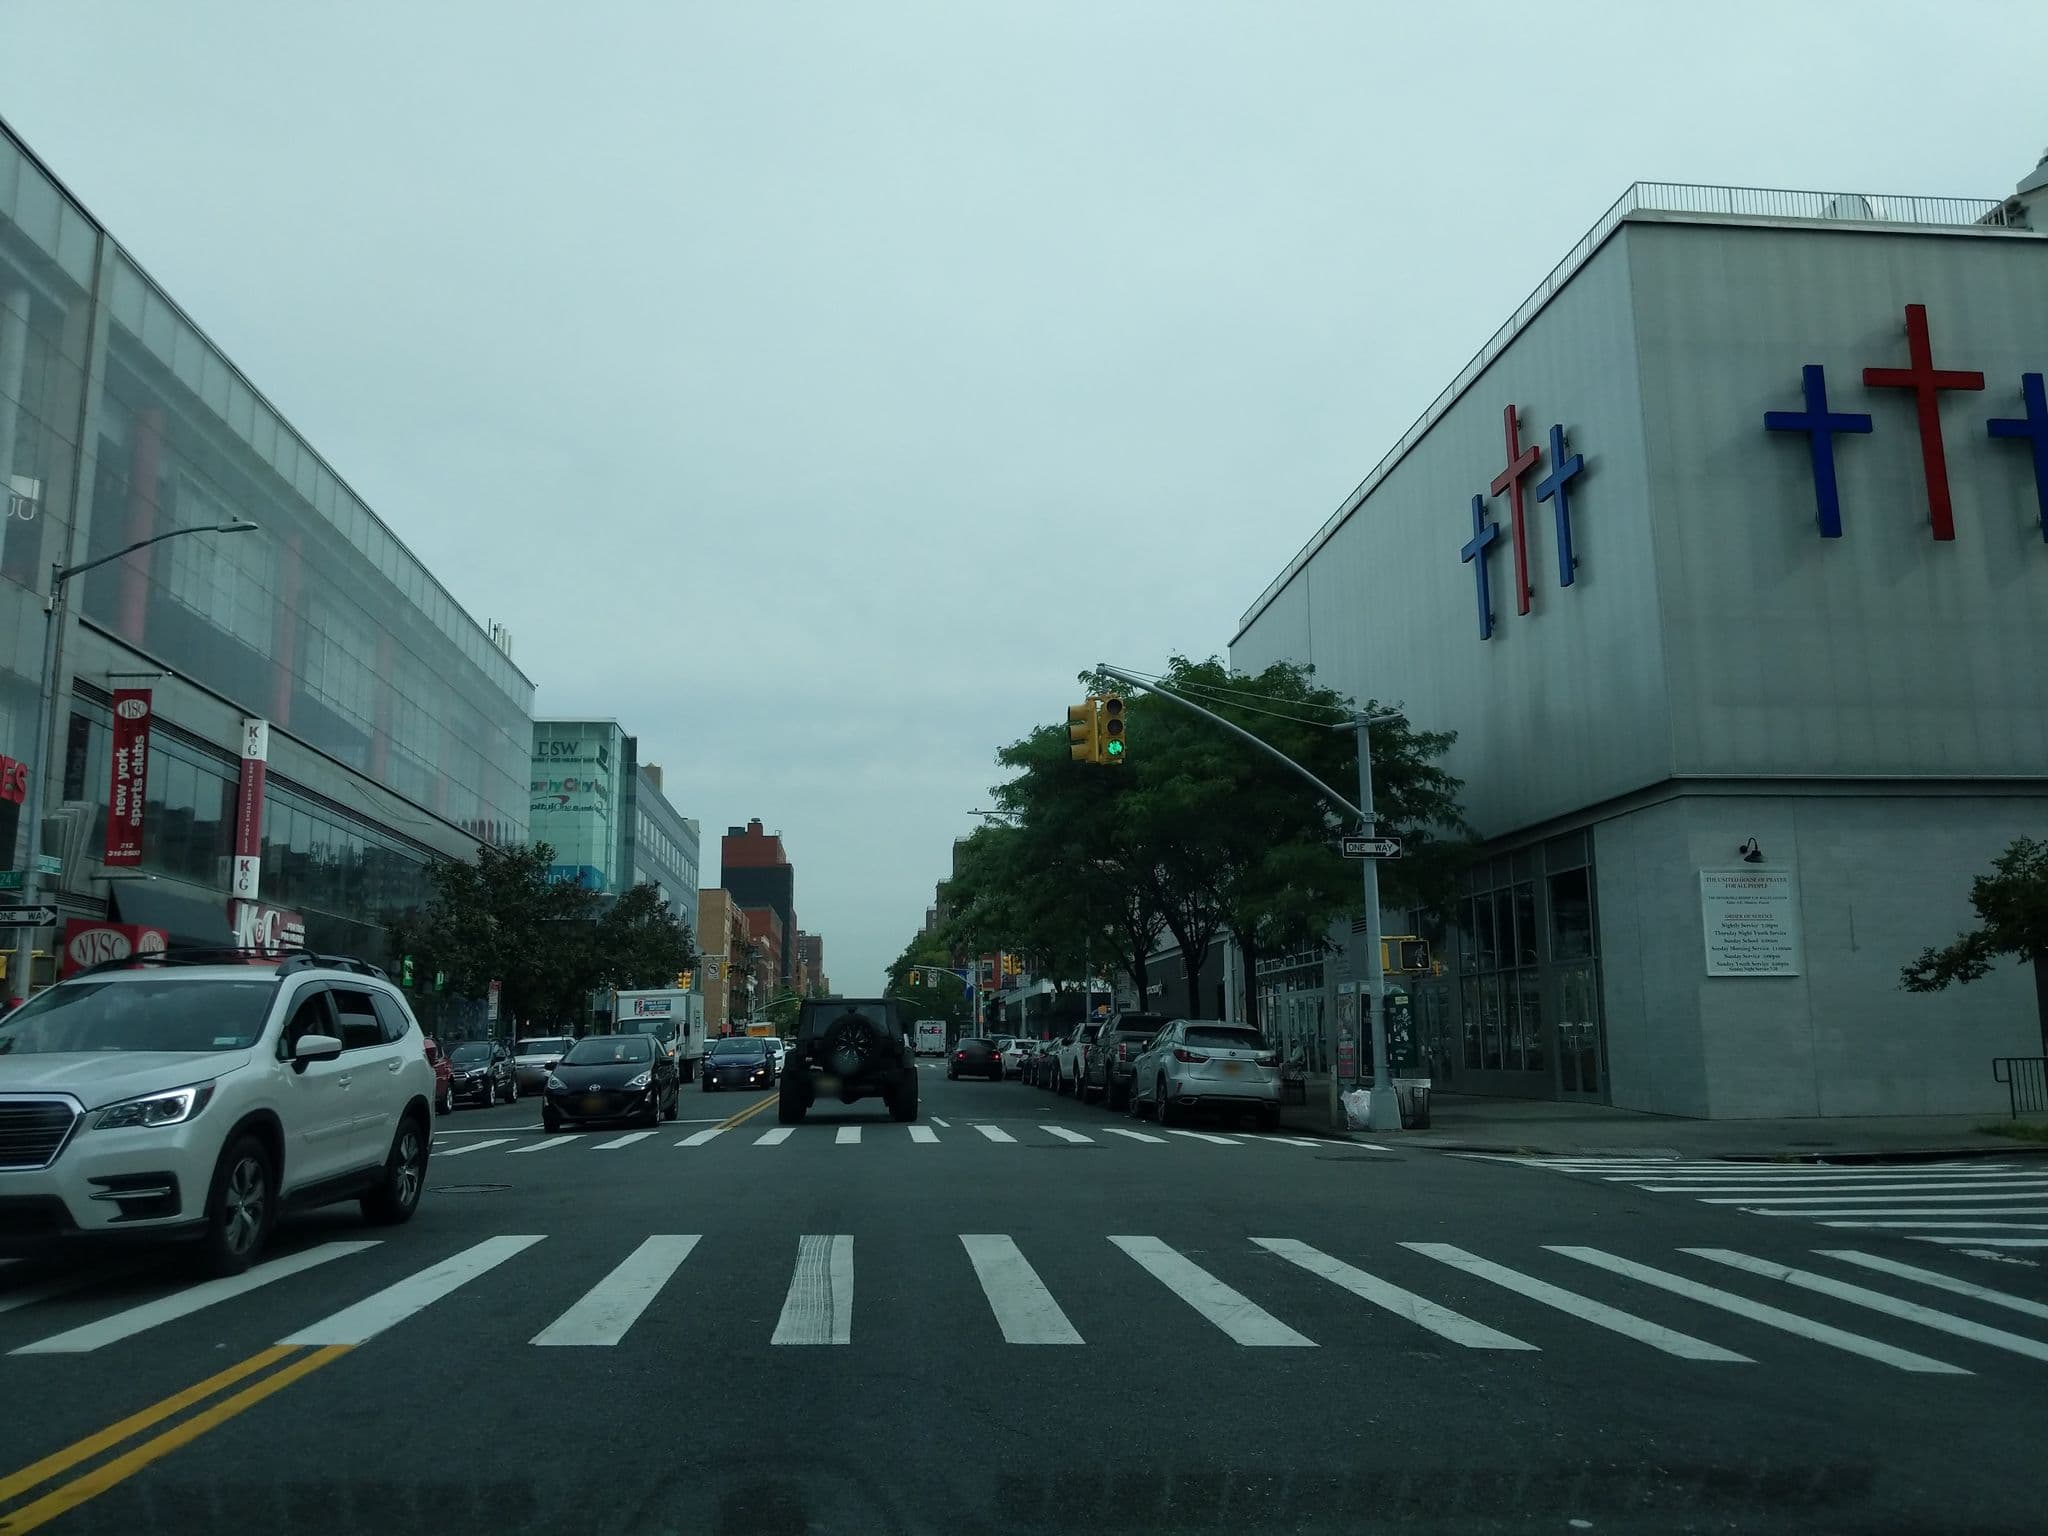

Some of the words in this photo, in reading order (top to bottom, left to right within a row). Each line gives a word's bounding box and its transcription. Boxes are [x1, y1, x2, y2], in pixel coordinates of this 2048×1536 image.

[116, 747, 129, 780] york
[132, 735, 145, 775] clubs
[0, 755, 28, 805] ES
[115, 784, 127, 816] new
[130, 777, 144, 826] sports
[1348, 843, 1366, 852] ONE
[1375, 844, 1393, 852] WAY
[0, 911, 17, 921] ONE
[28, 911, 49, 921] WAY
[78, 932, 128, 965] NYSC
[919, 1026, 942, 1035] FedEx
